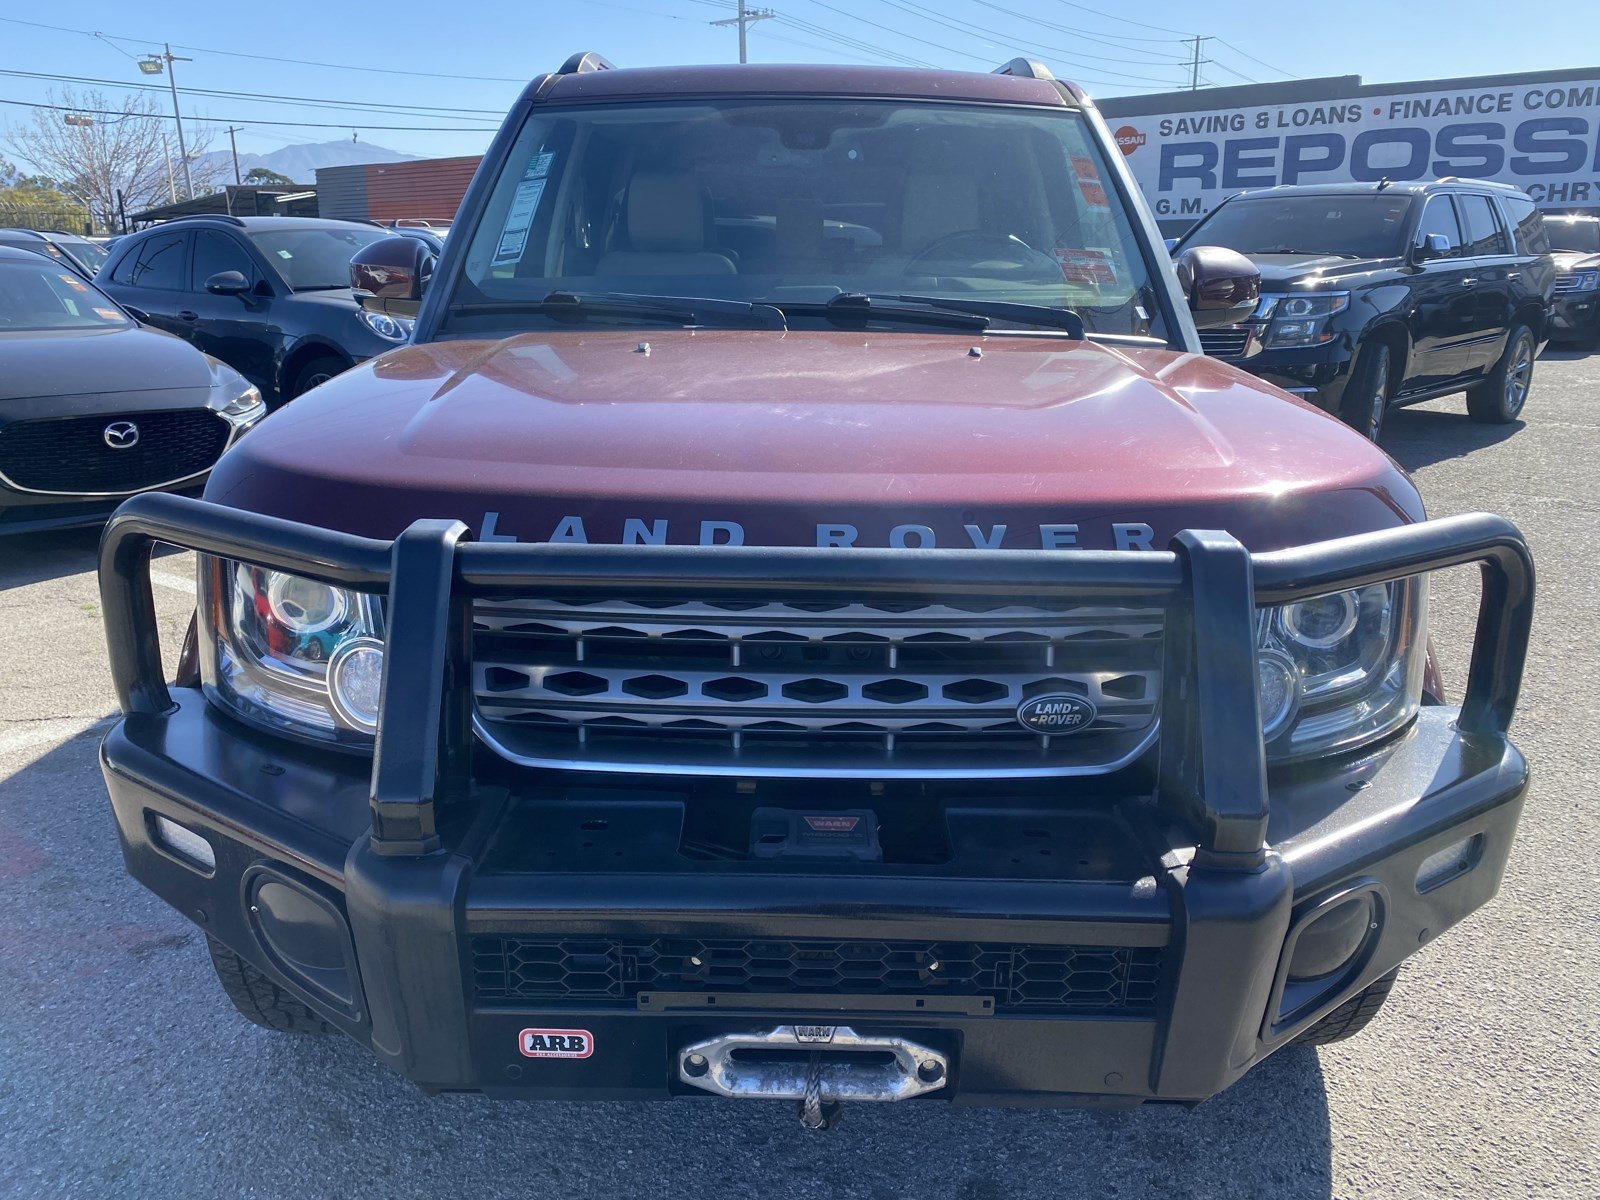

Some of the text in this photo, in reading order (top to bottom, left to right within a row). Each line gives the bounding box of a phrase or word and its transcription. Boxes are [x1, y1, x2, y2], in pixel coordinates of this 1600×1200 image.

[1159, 87, 1600, 137] SAVING & LOANS FINANCE COM
[1158, 117, 1600, 191] REPOSS
[1156, 198, 1208, 215] G.M.
[479, 512, 1156, 550] LAND ROVER
[530, 1034, 585, 1052] ARB
[799, 1026, 831, 1036] WARN
